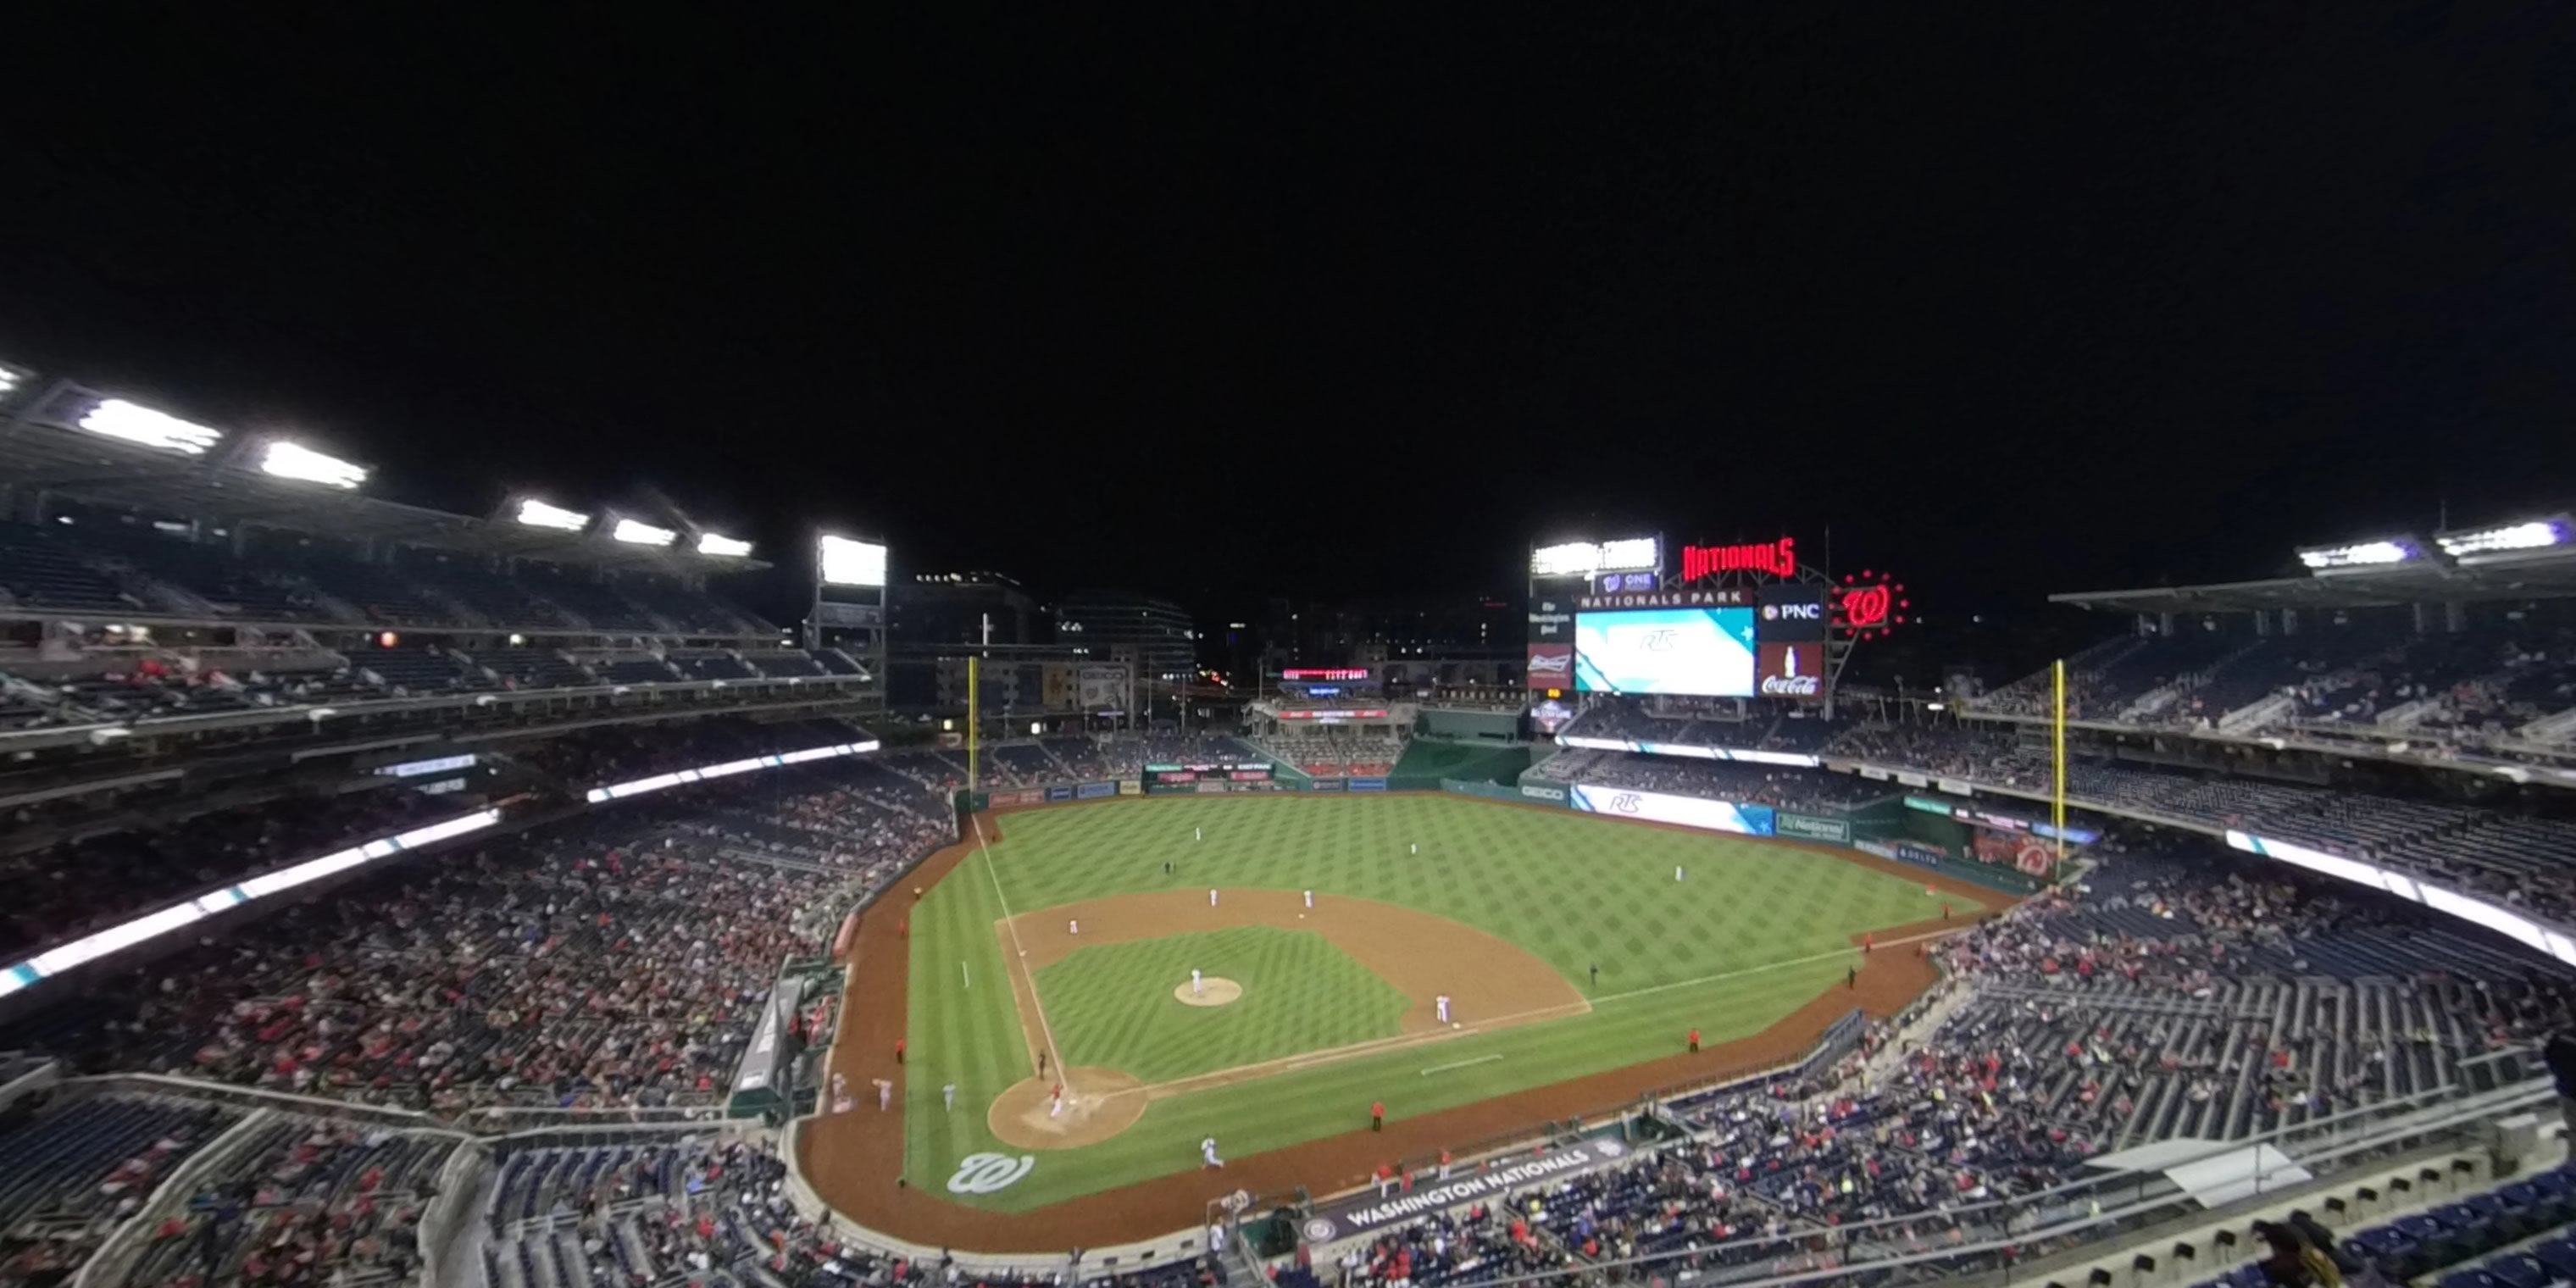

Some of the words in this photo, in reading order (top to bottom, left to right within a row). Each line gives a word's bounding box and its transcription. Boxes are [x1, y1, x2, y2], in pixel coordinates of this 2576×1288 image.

[1684, 537, 1794, 581] NATIONALS
[1580, 593, 1681, 608] NATIONALS
[1691, 591, 1741, 603] PARK
[1781, 603, 1819, 619] PNC
[1522, 786, 1564, 801] GEICO
[1609, 793, 1643, 813] RTS
[1795, 819, 1844, 835] National
[1907, 850, 1937, 864] DELTA
[1346, 1178, 1486, 1227] WASHINGTON
[1485, 1150, 1590, 1189] NATIONALS
